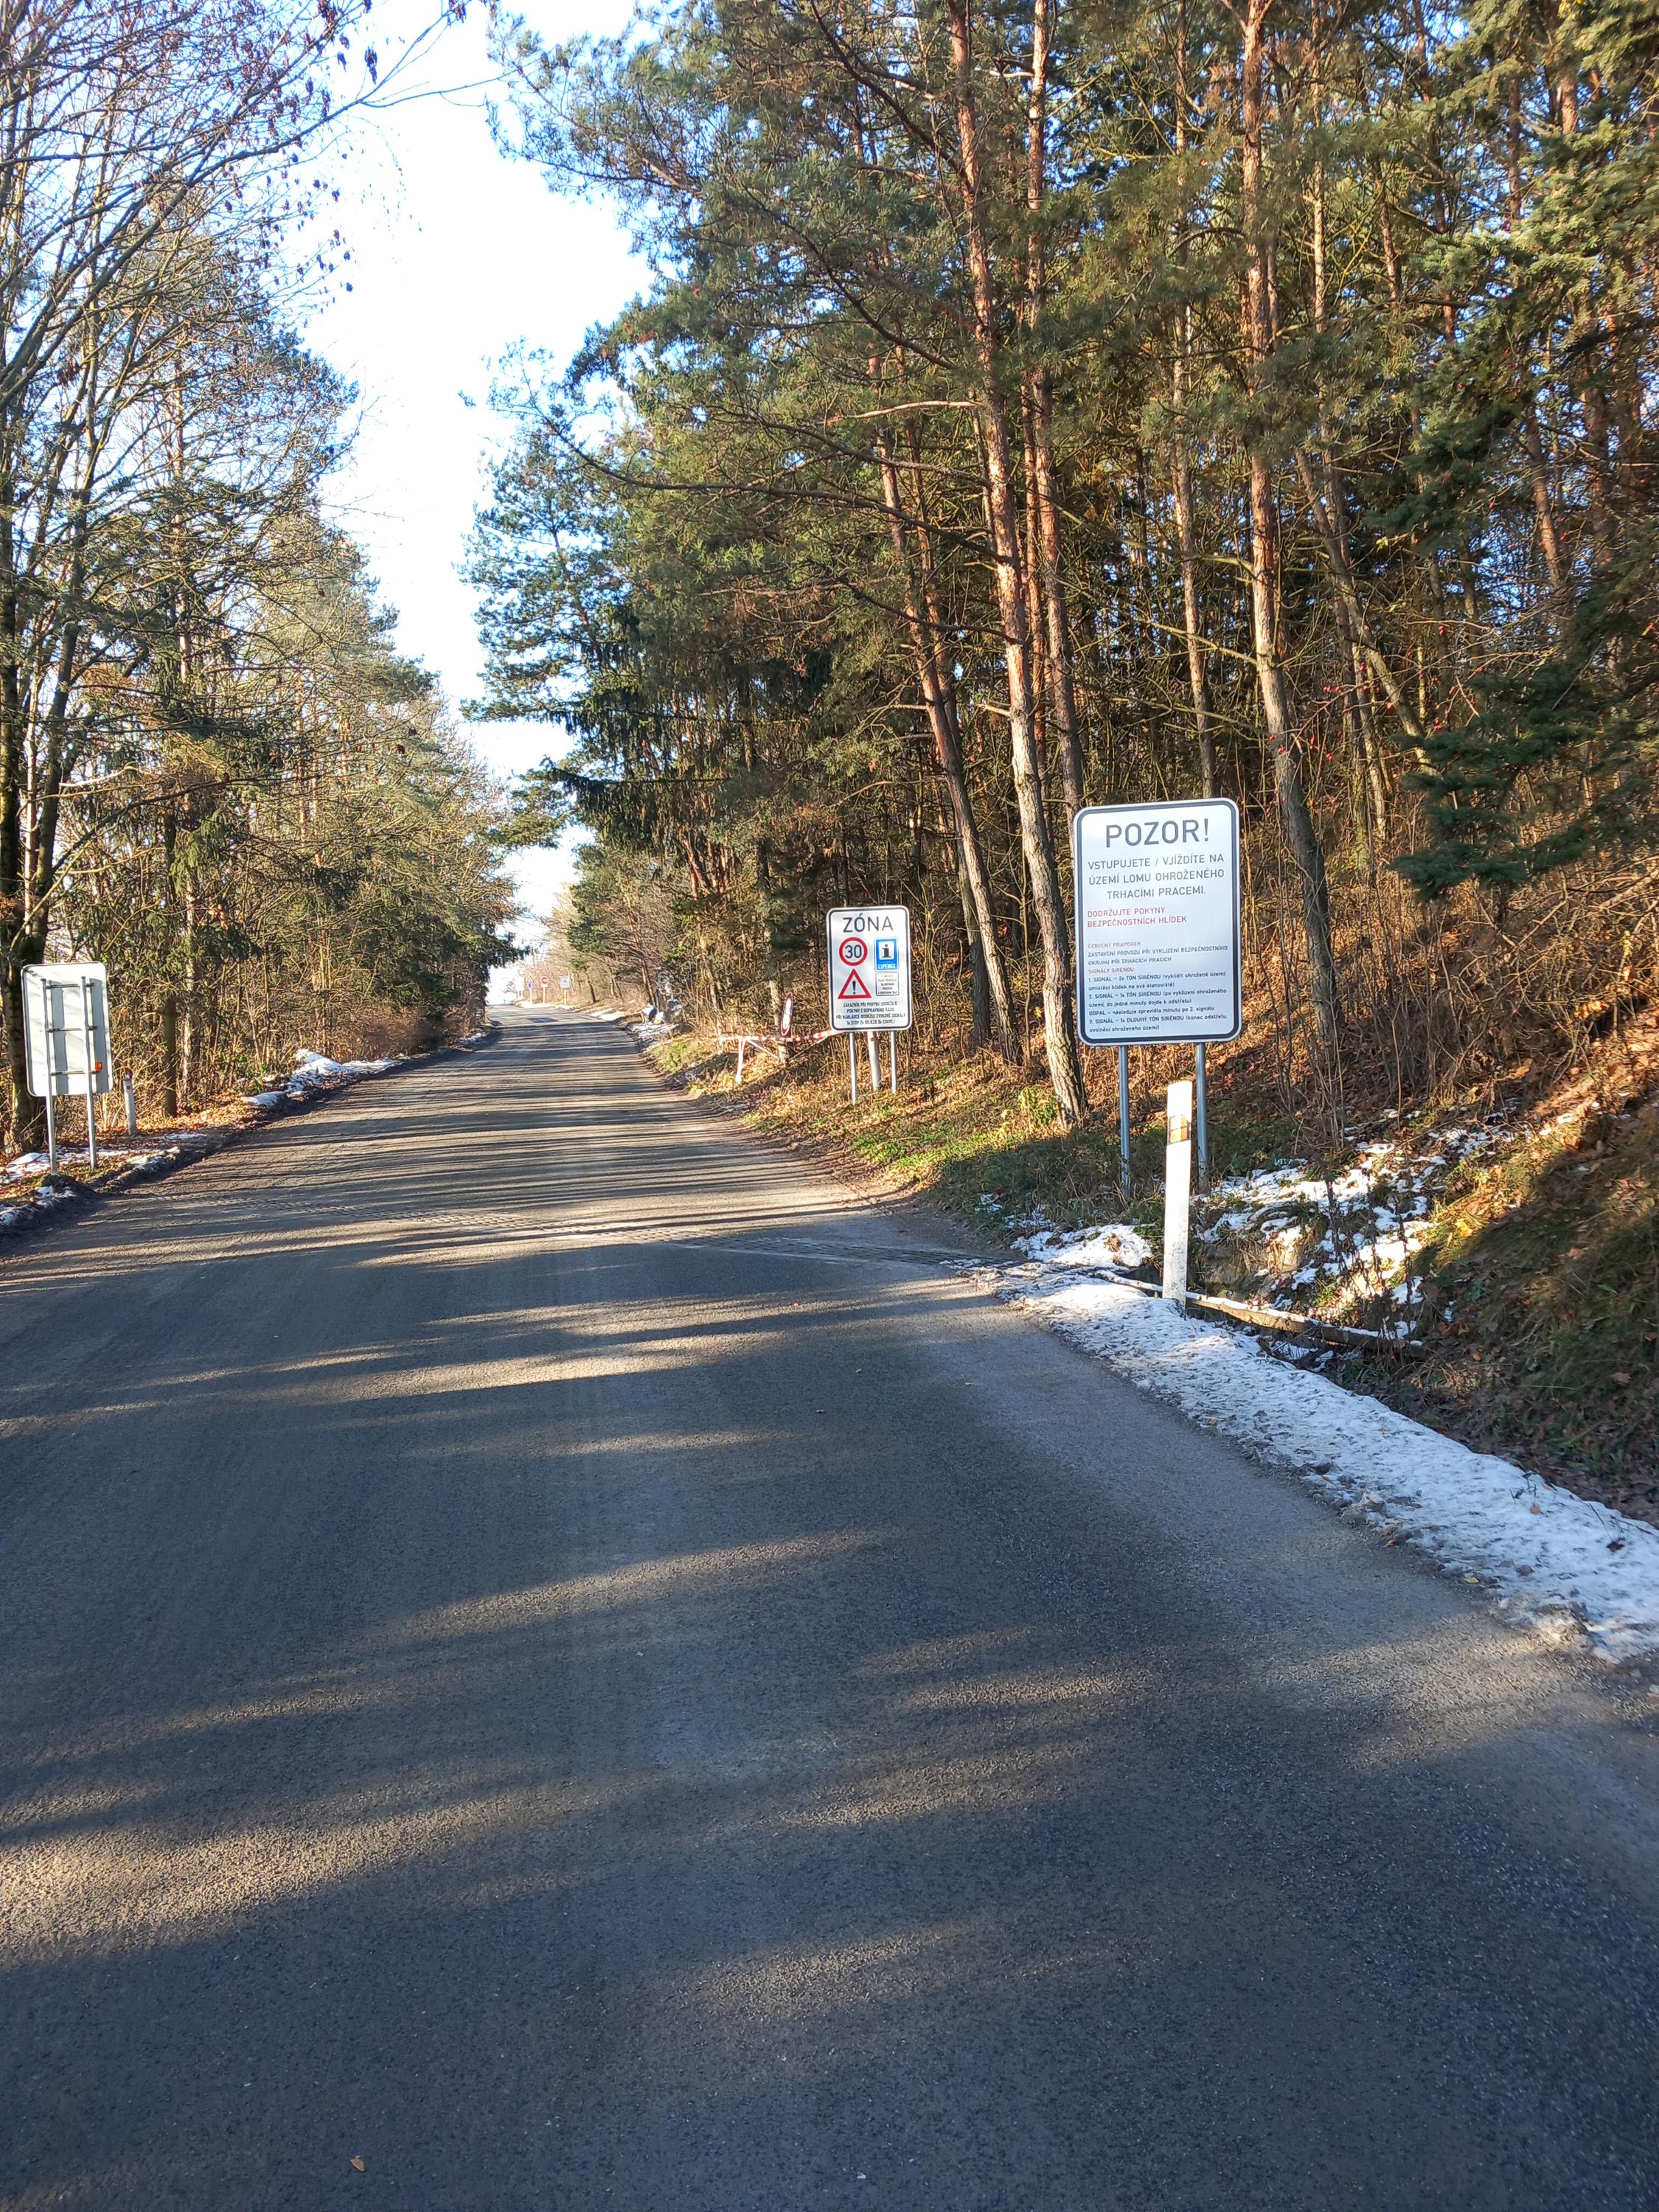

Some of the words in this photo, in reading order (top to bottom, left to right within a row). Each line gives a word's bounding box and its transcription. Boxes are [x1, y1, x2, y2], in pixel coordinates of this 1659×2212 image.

[1106, 818, 1208, 848] POZOR!
[1088, 858, 1150, 869] VSTUPUJETE
[1163, 853, 1205, 865] VJÍŽDÍTE
[1210, 854, 1224, 862] NA
[1089, 874, 1119, 885] ÚZEMÍ
[1124, 874, 1151, 883] LOMU
[1155, 869, 1224, 881] OHROŽENÉHO
[1107, 888, 1154, 899] TRHACÍMI
[1088, 908, 1131, 917] DODRŽUJTE
[843, 913, 893, 933] ZÓNA
[1088, 917, 1155, 928] BEZPEČNOSTNÍCH
[845, 945, 861, 959] 30
